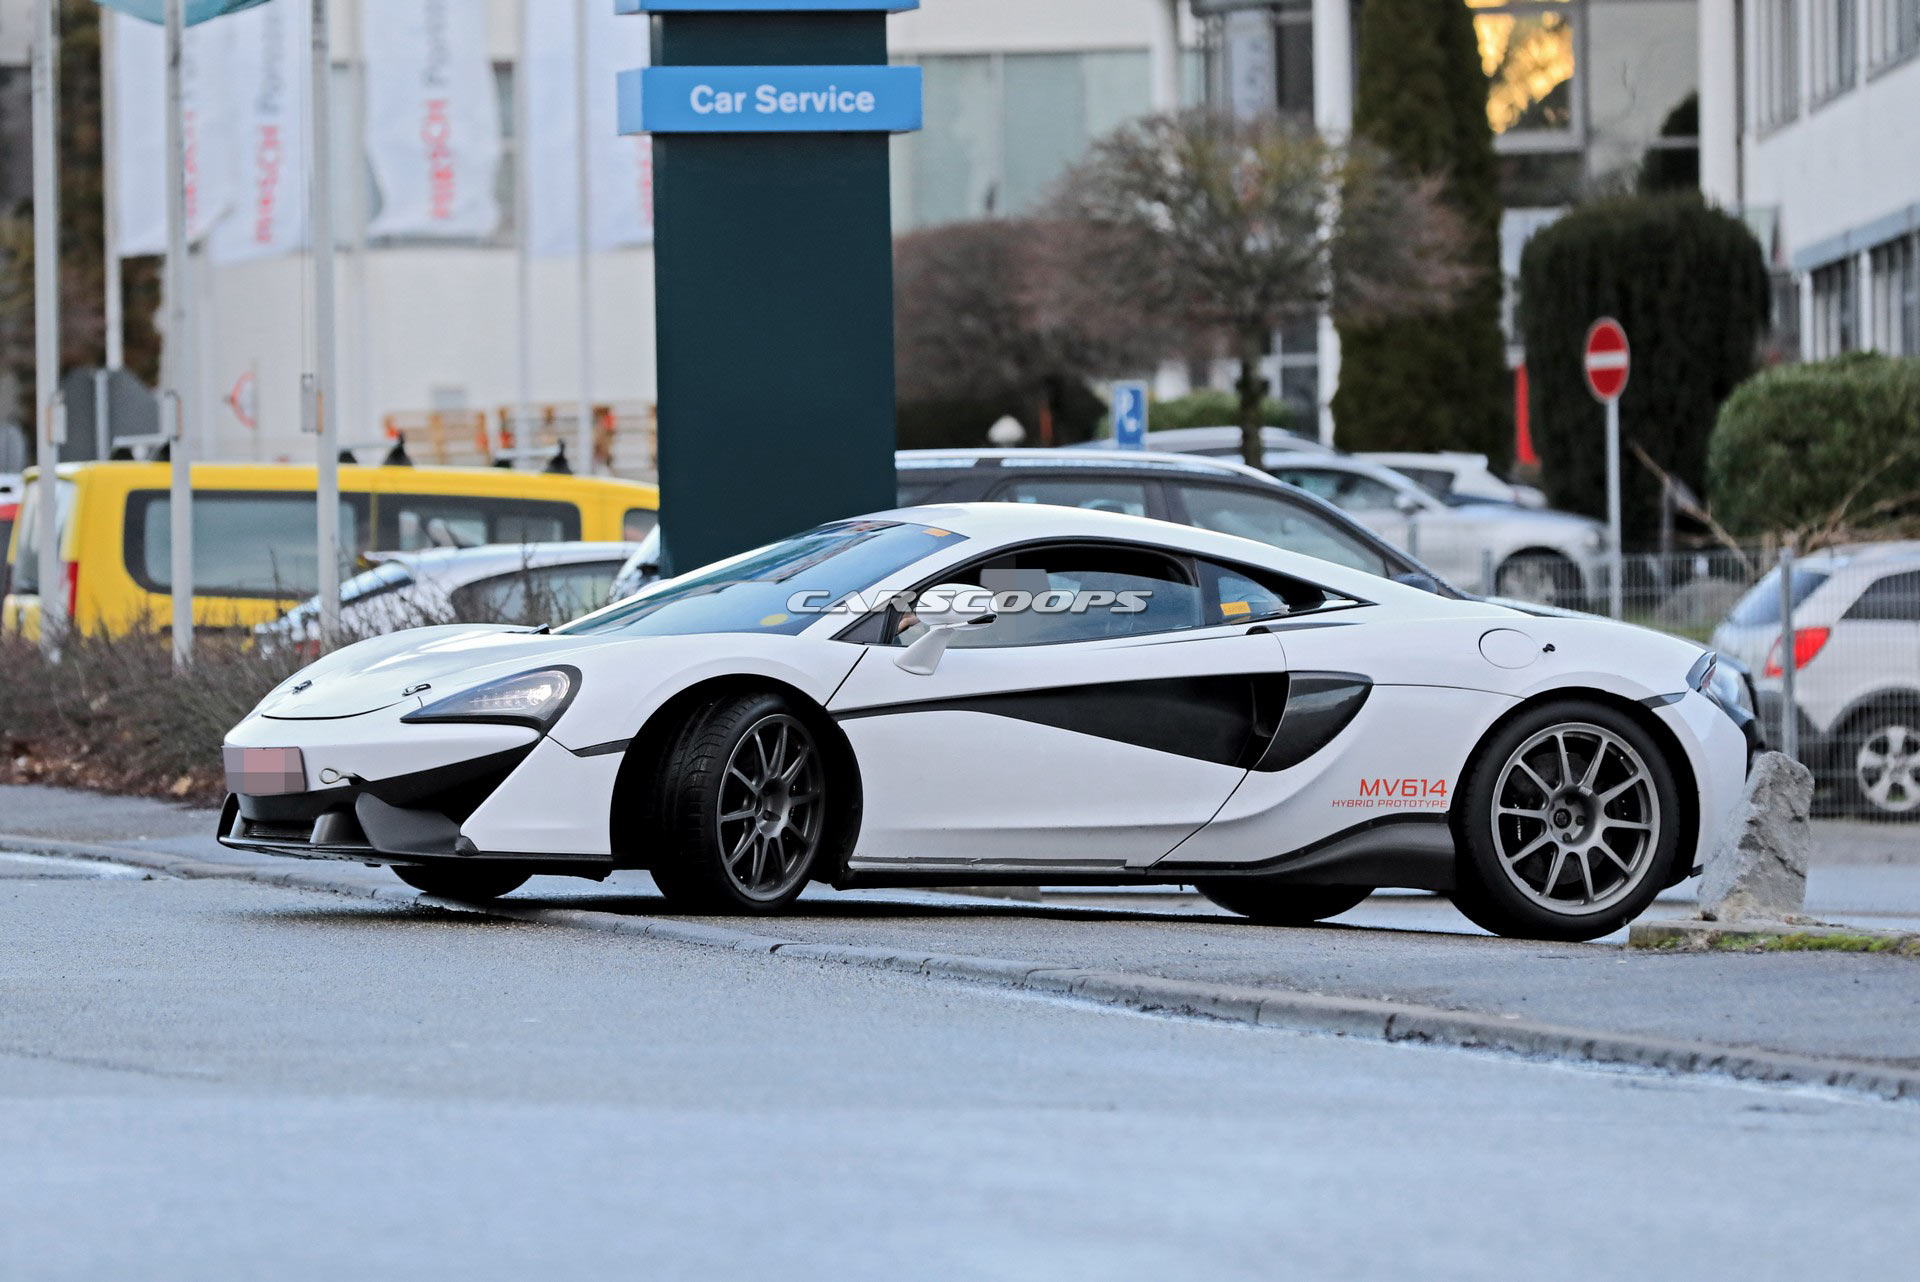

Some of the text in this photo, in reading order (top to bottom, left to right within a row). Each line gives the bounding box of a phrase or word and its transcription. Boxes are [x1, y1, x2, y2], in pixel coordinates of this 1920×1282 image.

[690, 84, 875, 114] Car Service
[1360, 779, 1447, 797] MV614
[1331, 799, 1447, 808] HYBRID PROTOTYPE
